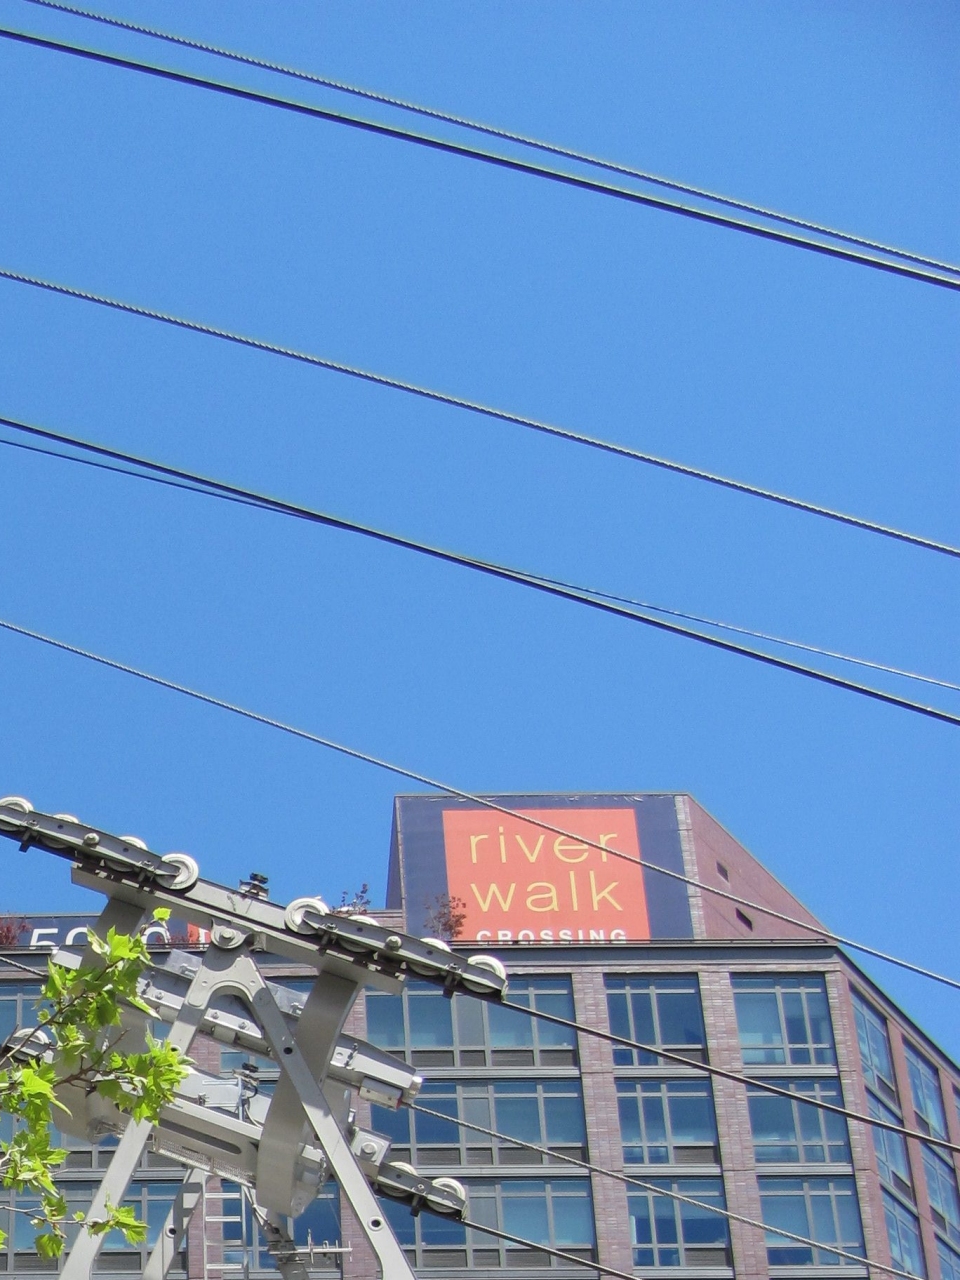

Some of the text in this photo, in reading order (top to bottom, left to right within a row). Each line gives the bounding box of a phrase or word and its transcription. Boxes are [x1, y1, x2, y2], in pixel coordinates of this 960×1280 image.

[470, 826, 618, 864] river
[470, 870, 623, 912] walk
[476, 929, 627, 944] CROSSING
